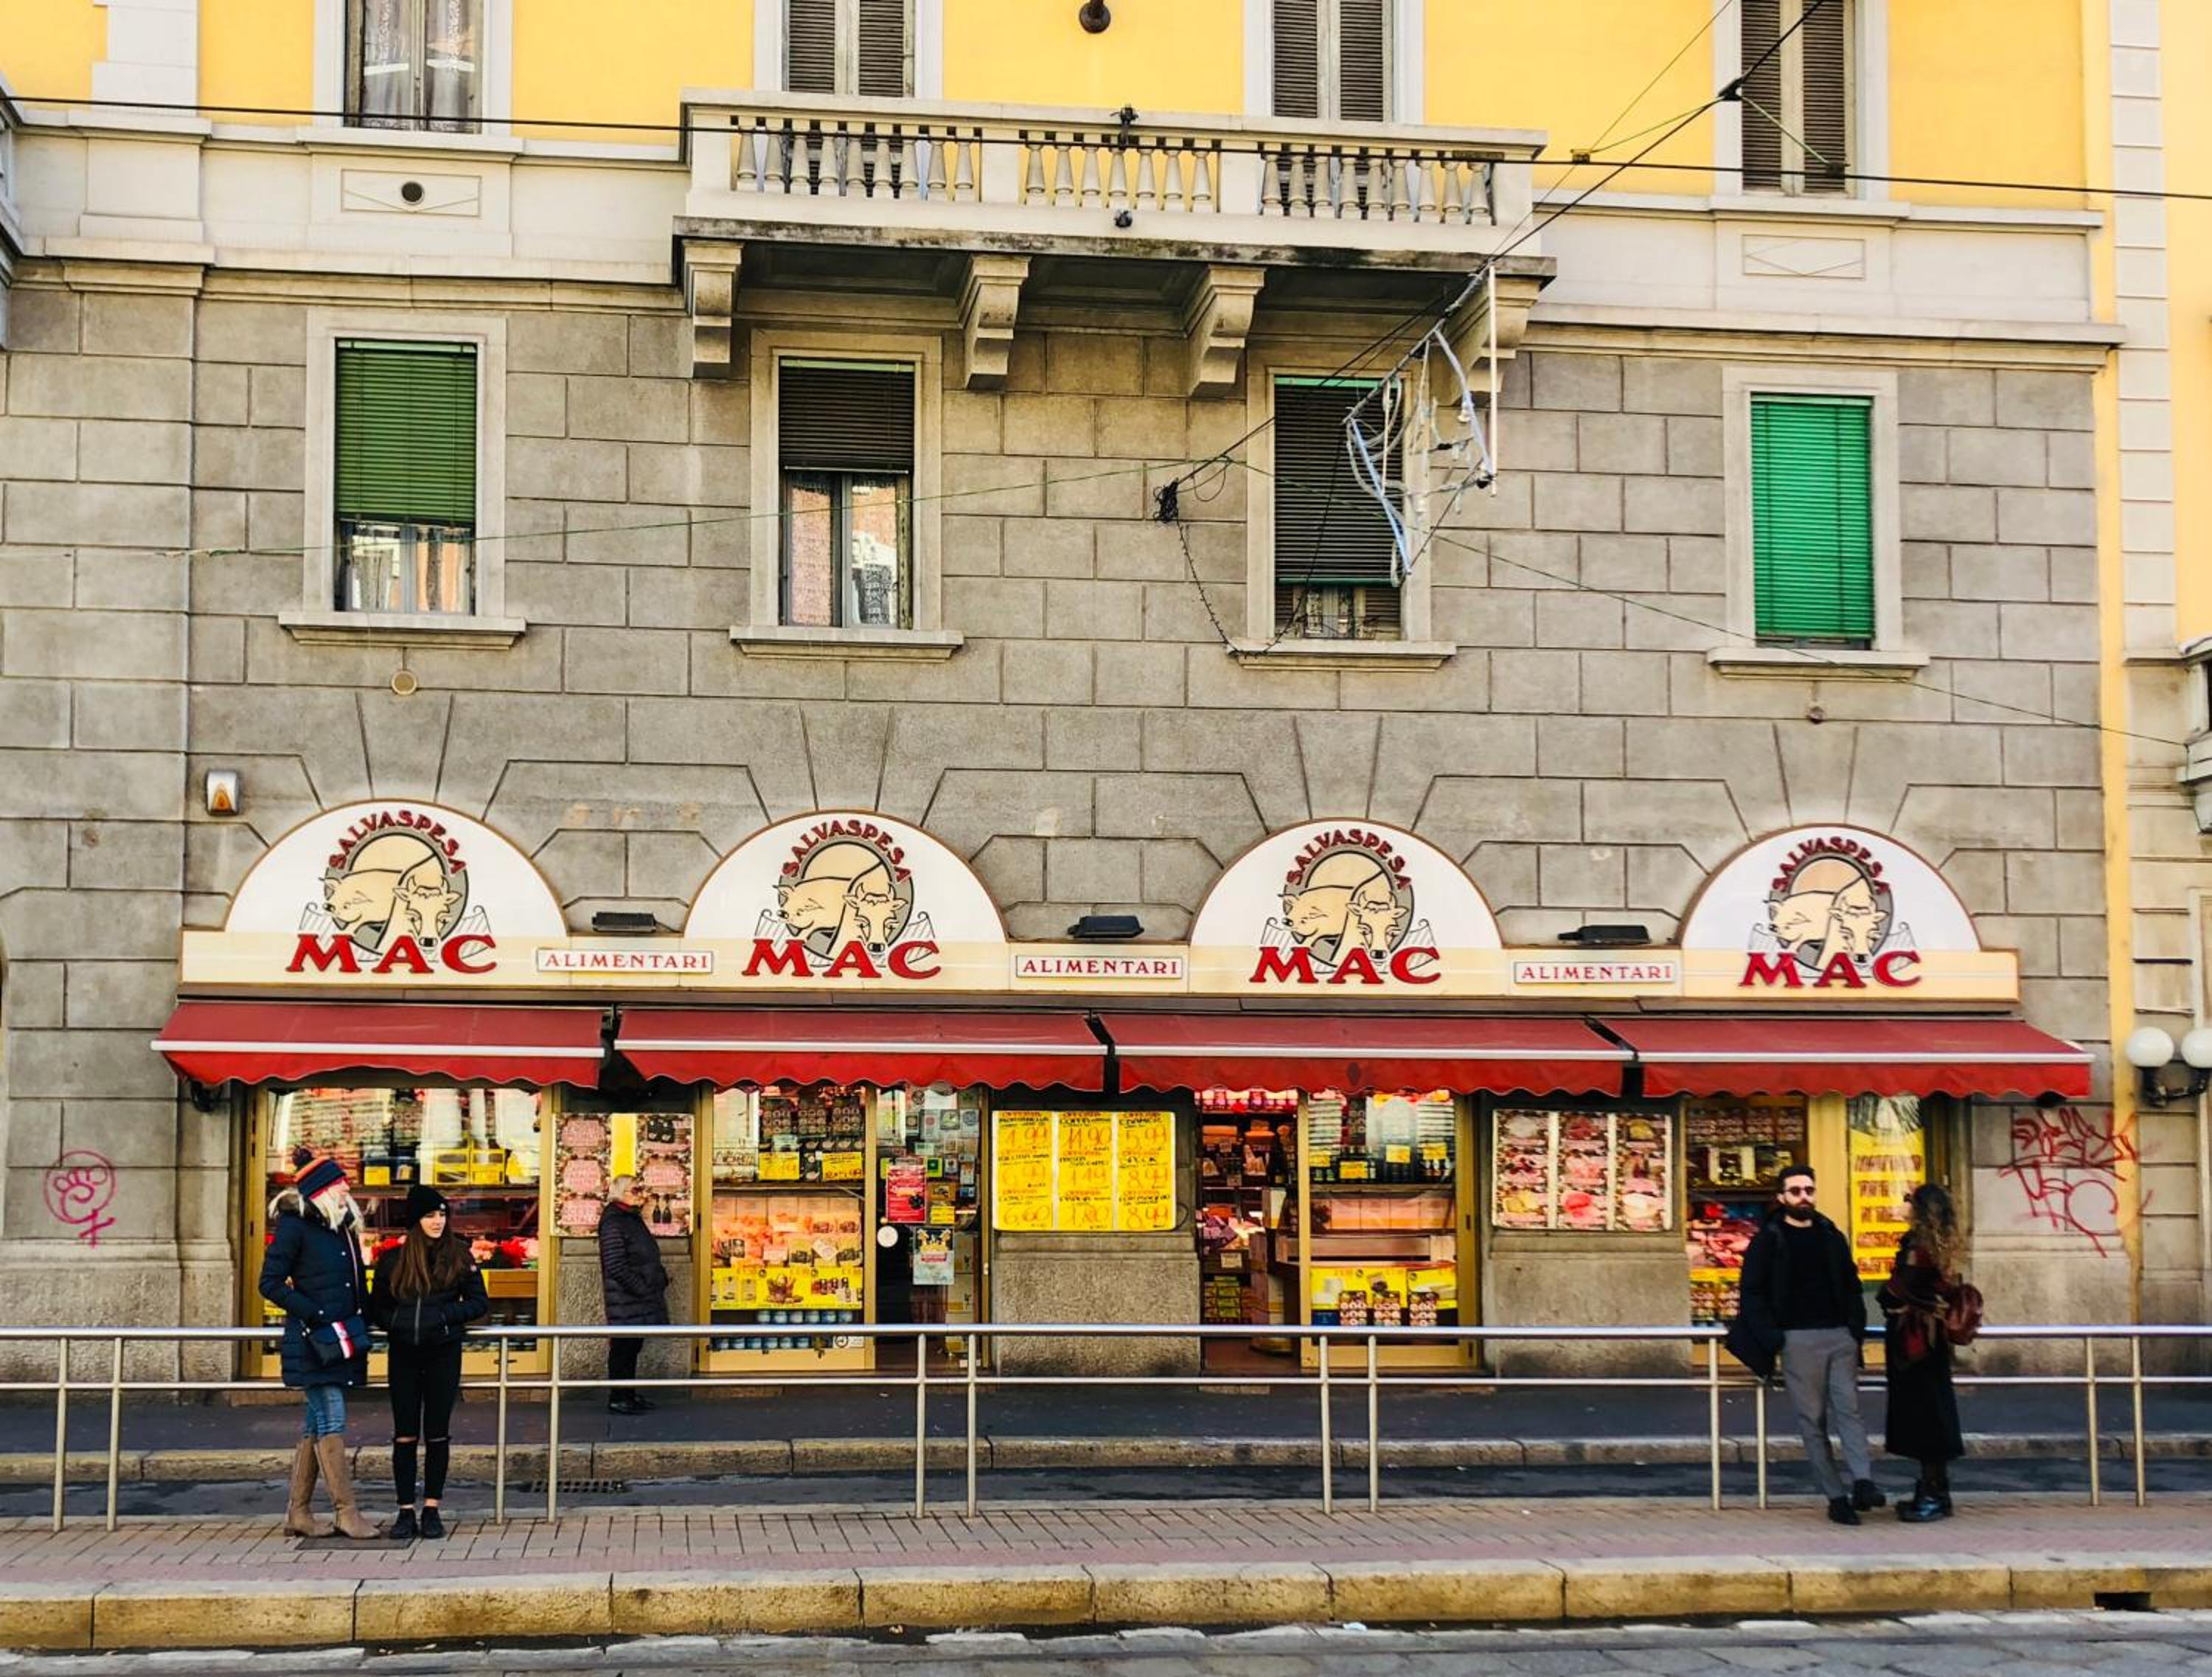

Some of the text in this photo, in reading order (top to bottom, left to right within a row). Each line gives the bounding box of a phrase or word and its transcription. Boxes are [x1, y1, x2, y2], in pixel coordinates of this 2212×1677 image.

[330, 810, 466, 873] SALVASPESA
[782, 820, 912, 883] SALVASPESA
[1286, 829, 1411, 889] SALVASPESA
[1772, 836, 1890, 895] SALVASPESA
[285, 934, 498, 973] MAC
[544, 953, 709, 969] ALIMENTARI
[741, 939, 942, 979] MAC
[1022, 959, 1178, 975] ALIMENTARI
[1249, 946, 1441, 985] MAC
[1521, 966, 1672, 980] ALIMENTARI
[1738, 950, 1923, 989] MAC
